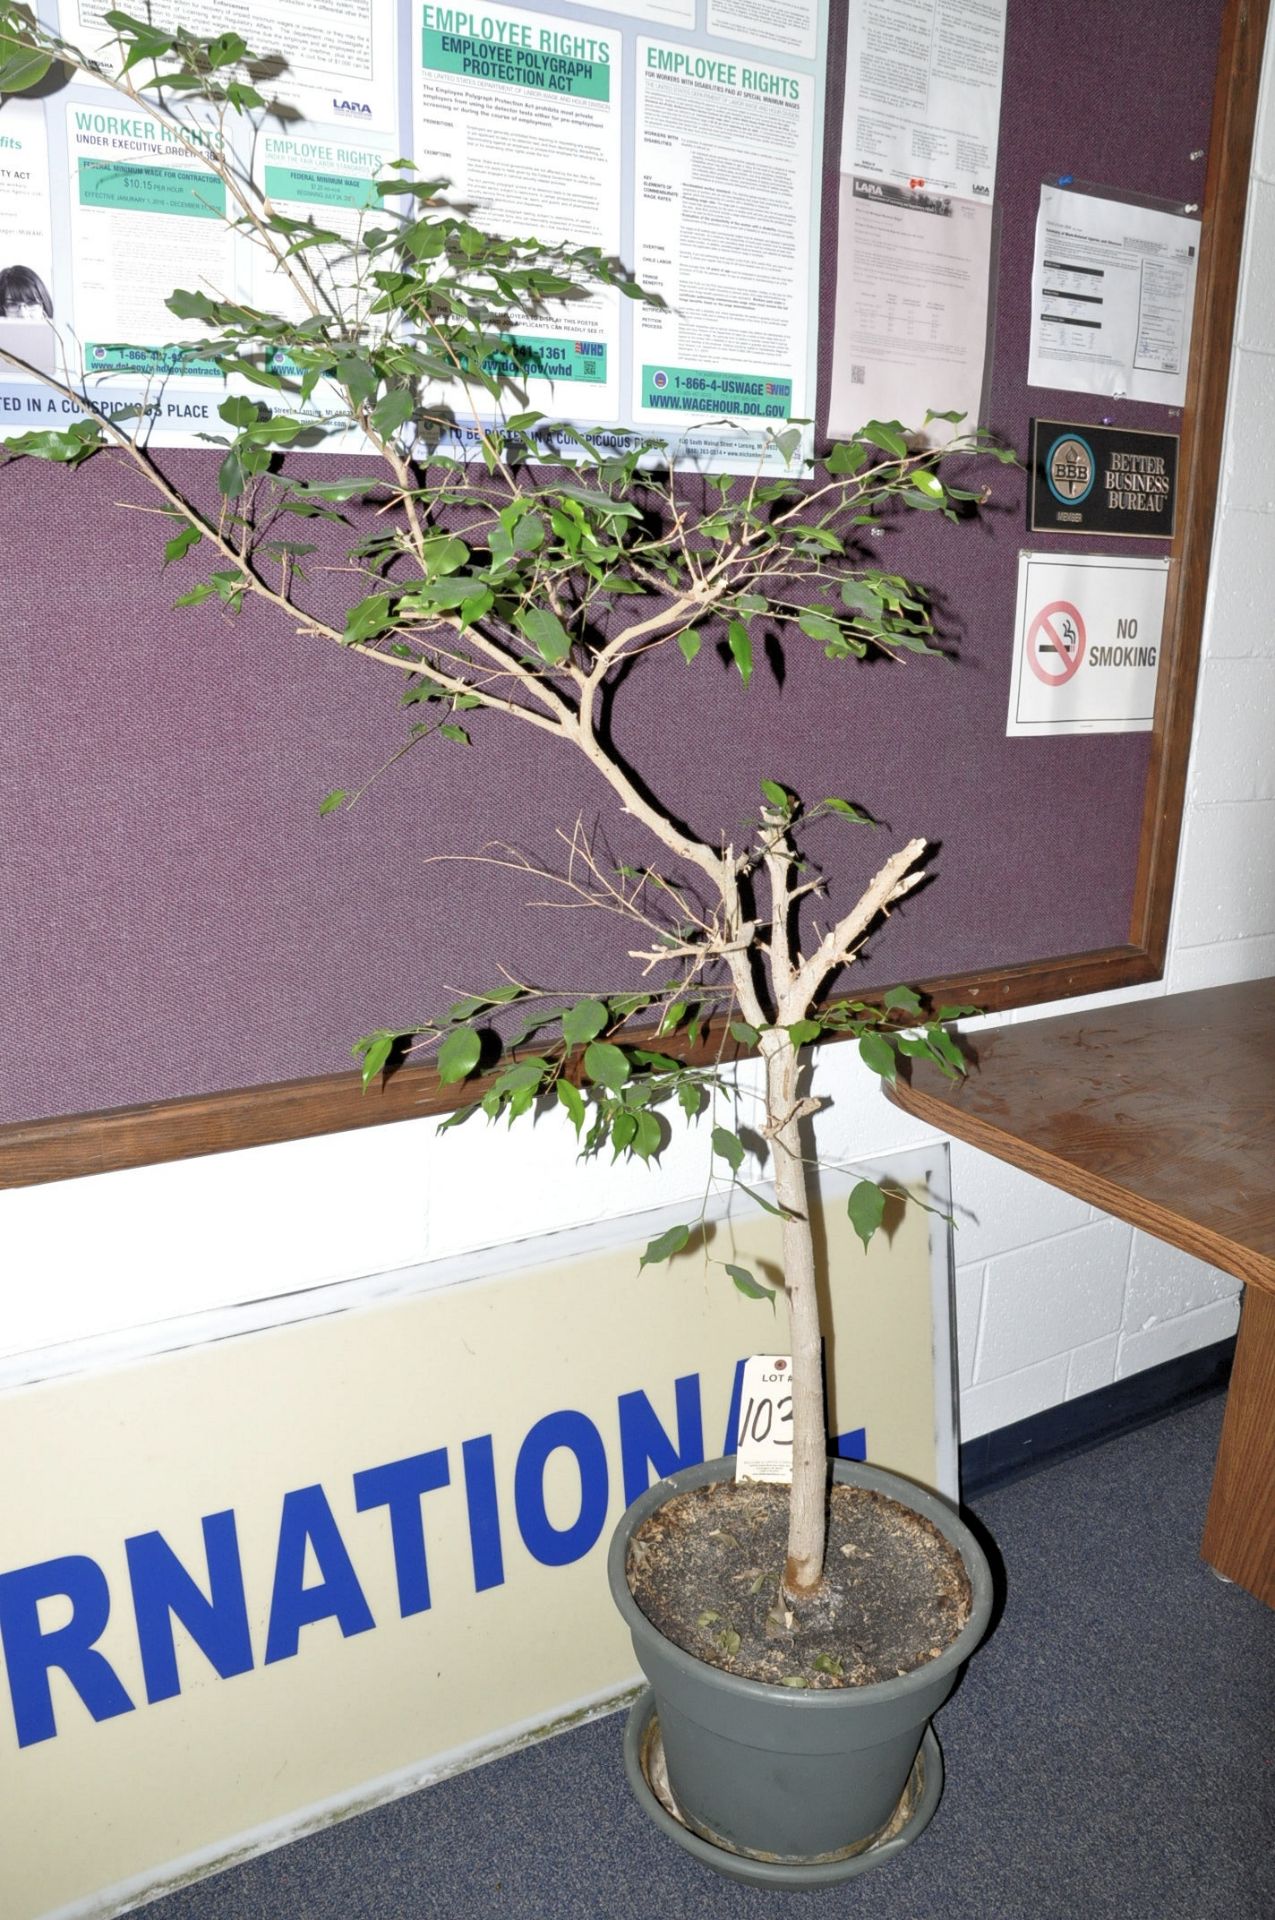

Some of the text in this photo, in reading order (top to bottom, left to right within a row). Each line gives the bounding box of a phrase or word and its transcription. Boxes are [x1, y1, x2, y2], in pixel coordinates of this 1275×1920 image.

[423, 4, 611, 64] EMPLOYEE RIGHTS
[442, 36, 593, 80] EMPLOYEE POLYGRAPH
[463, 57, 574, 93] PROTECTION ACT
[646, 46, 737, 86] EMPLOYEE
[741, 68, 800, 100] RIGHTS
[656, 73, 680, 84] WORKERS
[333, 98, 372, 114] LARA
[75, 111, 155, 140] WORKER
[76, 134, 109, 147] UNDER
[112, 138, 163, 155] EXECUTIVE
[265, 138, 382, 168] EMPLOYEE RIGHTS
[14, 171, 31, 180] ACT
[123, 177, 152, 191] $10.15
[581, 341, 604, 357] WHD
[674, 375, 764, 396] 1-866-4-USWAGE
[27, 397, 42, 412] IN
[47, 399, 57, 413] A
[167, 404, 210, 419] PLACE
[649, 394, 786, 418] WWW.WAGEHOUR.DOL.GOV
[466, 430, 480, 441] BE
[530, 432, 544, 443] IN
[556, 434, 631, 449] CONPICUOUS
[1054, 463, 1088, 480] BBB
[1111, 451, 1166, 476] BETTER
[1105, 470, 1170, 494] BUSINESS
[1109, 491, 1165, 513] BUREAU
[1056, 511, 1084, 523] MEMBER
[1116, 617, 1138, 639] NO
[1088, 645, 1157, 667] SMOKING
[762, 1374, 785, 1383] LOT
[0, 1357, 867, 1750] RNATION
